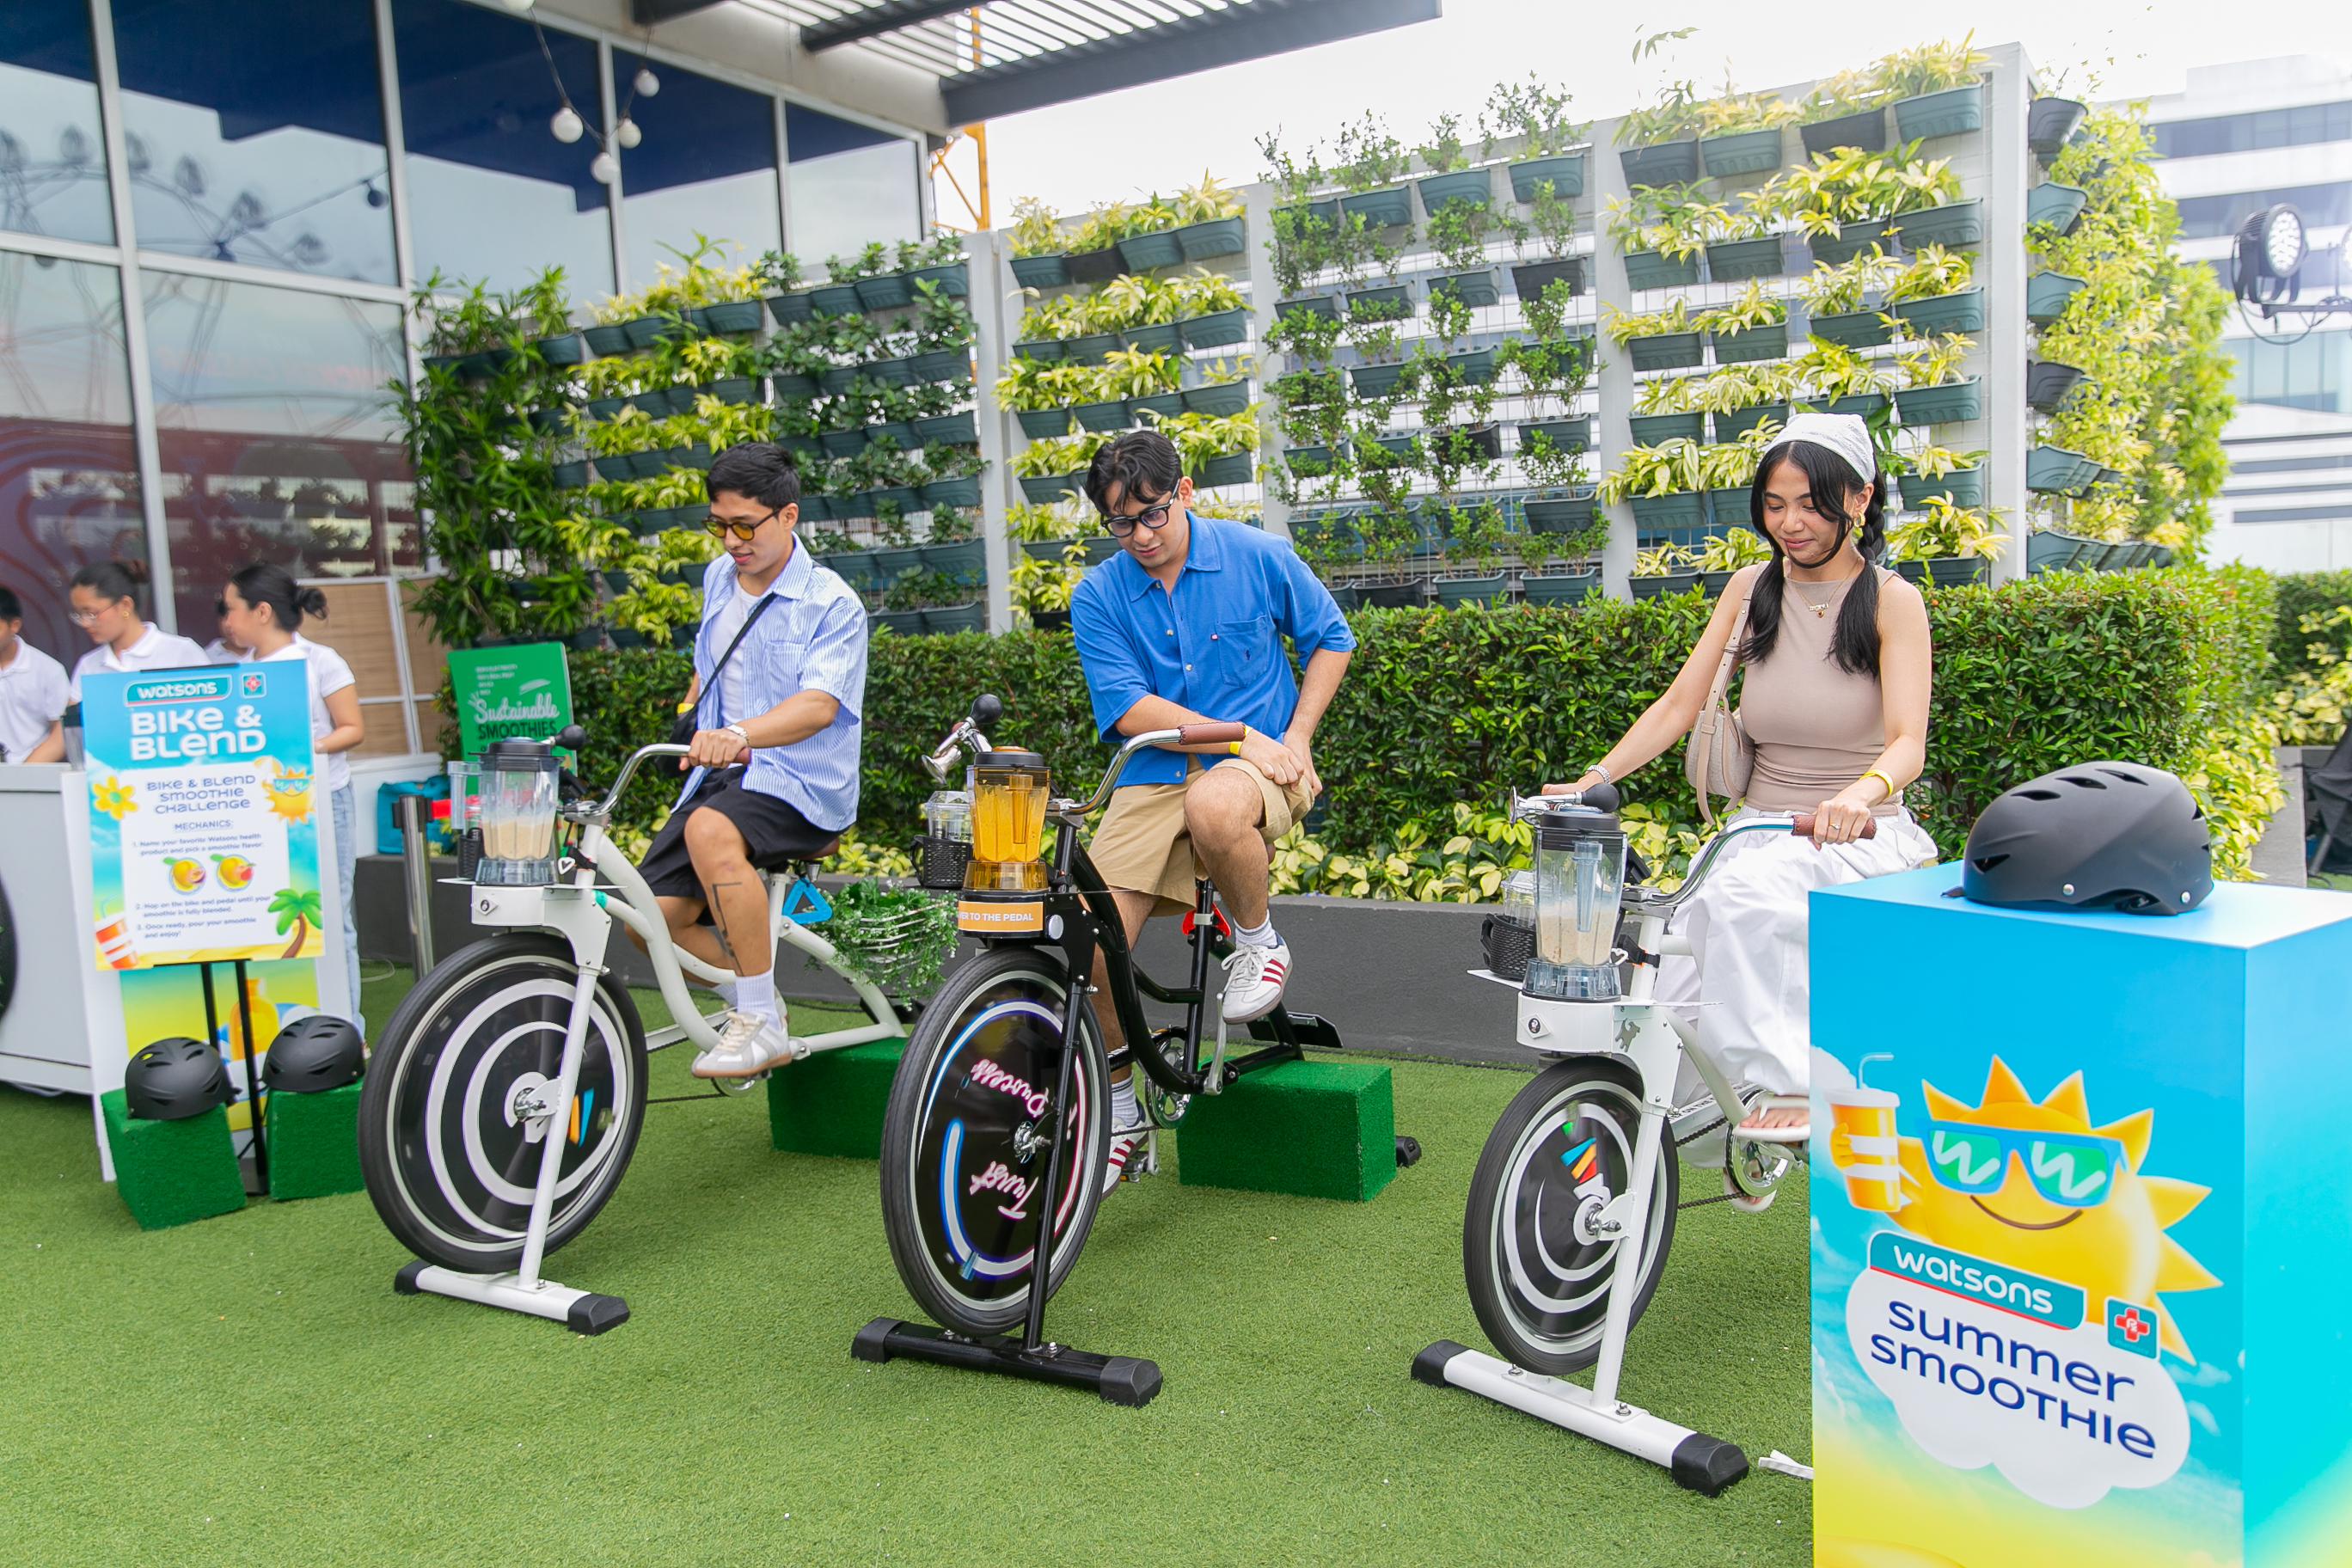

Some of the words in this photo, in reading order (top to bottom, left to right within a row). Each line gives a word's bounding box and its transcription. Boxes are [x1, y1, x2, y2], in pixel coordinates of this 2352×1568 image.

[137, 682, 217, 699] watsons
[235, 705, 263, 728] &
[474, 693, 560, 724] Sustainable
[478, 720, 557, 740] SMOOTHIES
[188, 779, 198, 788] &
[175, 819, 234, 830] MECHANICS:
[970, 912, 981, 921] TO
[983, 913, 1001, 922] THE
[1002, 913, 1033, 922] PEDAL
[1893, 1245, 2053, 1314] watsons
